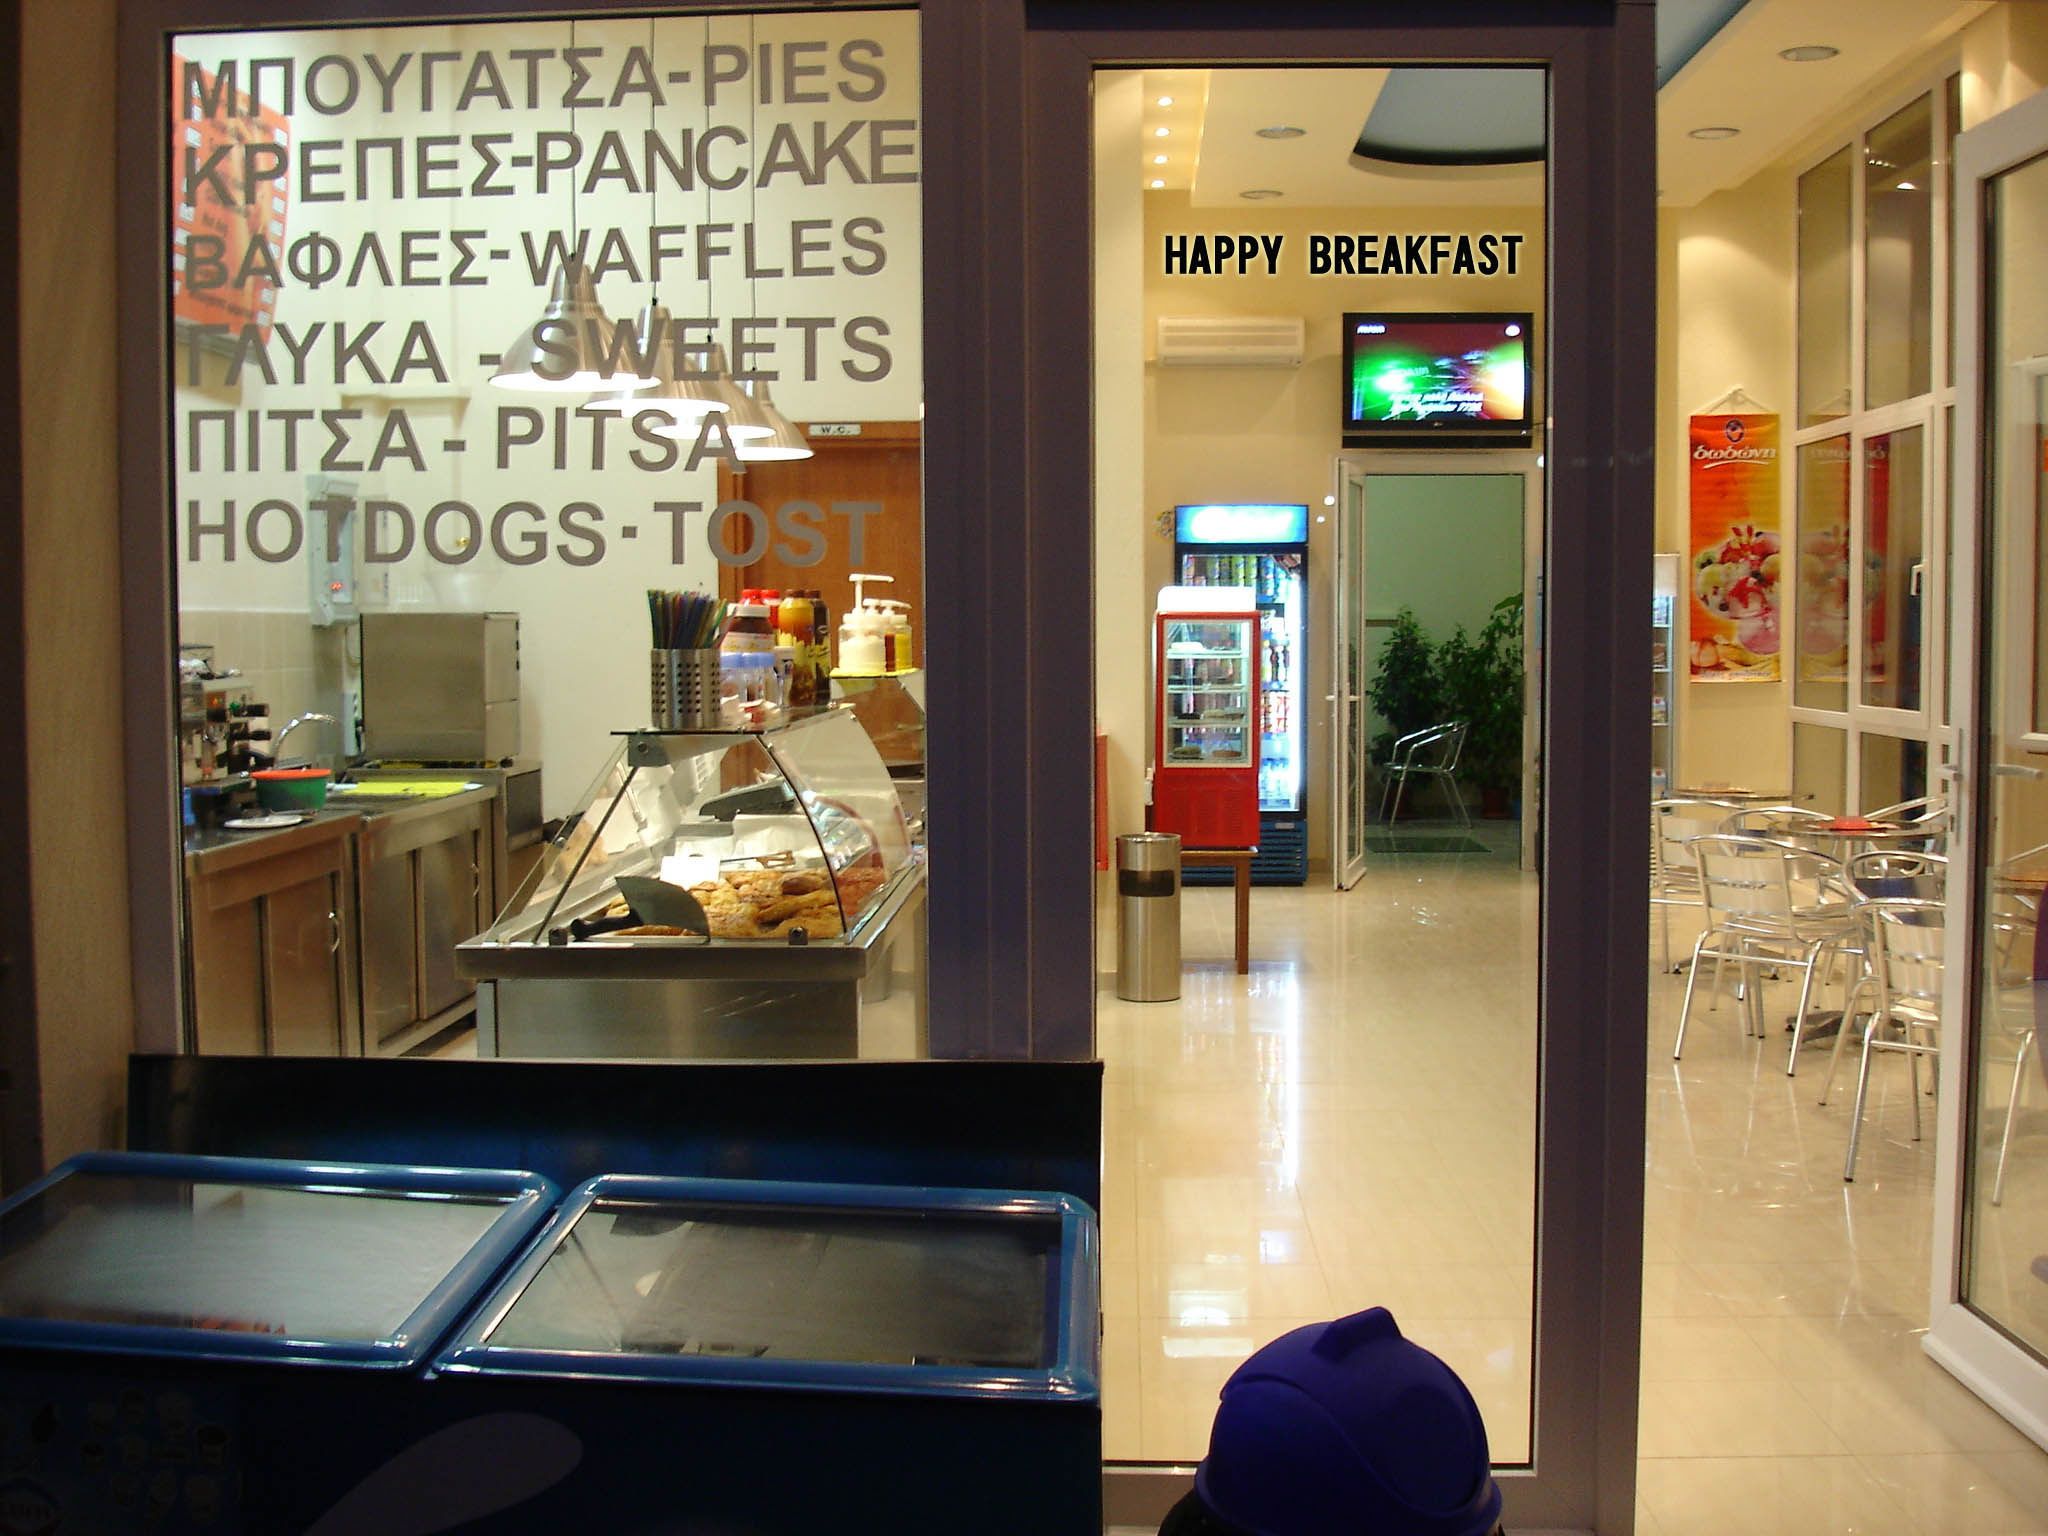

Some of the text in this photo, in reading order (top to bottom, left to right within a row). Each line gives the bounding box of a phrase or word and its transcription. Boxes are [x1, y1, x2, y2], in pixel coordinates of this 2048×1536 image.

[187, 321, 450, 387] ΓΛΥΚΑ
[529, 315, 894, 383] SWEETS
[496, 405, 748, 474] PITSA
